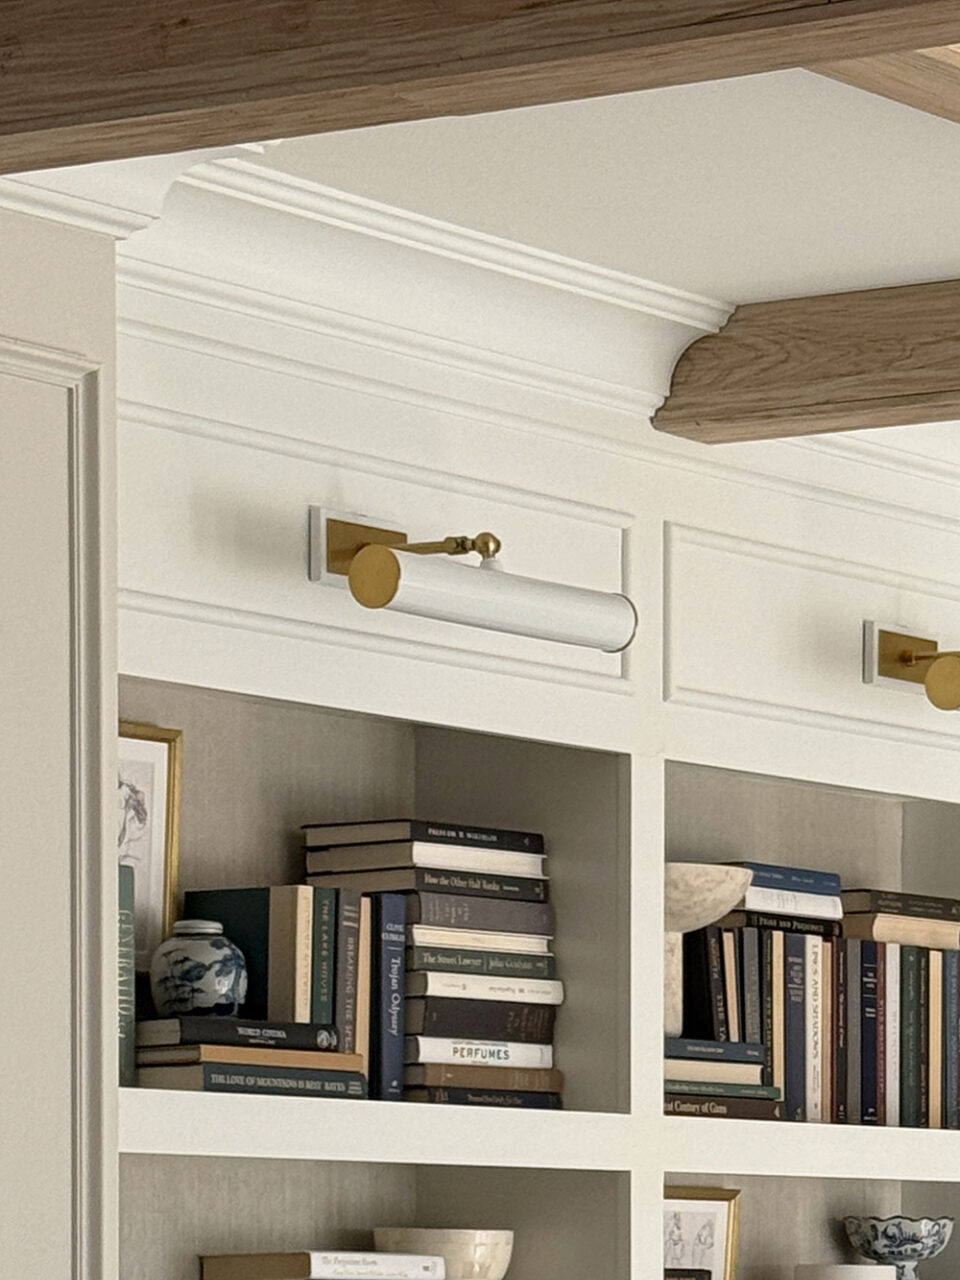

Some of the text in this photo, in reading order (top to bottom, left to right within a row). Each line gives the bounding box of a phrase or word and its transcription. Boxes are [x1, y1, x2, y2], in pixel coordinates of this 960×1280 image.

[387, 956, 402, 1037] Trojan Odyssey
[452, 1046, 510, 1060] PERFUMES
